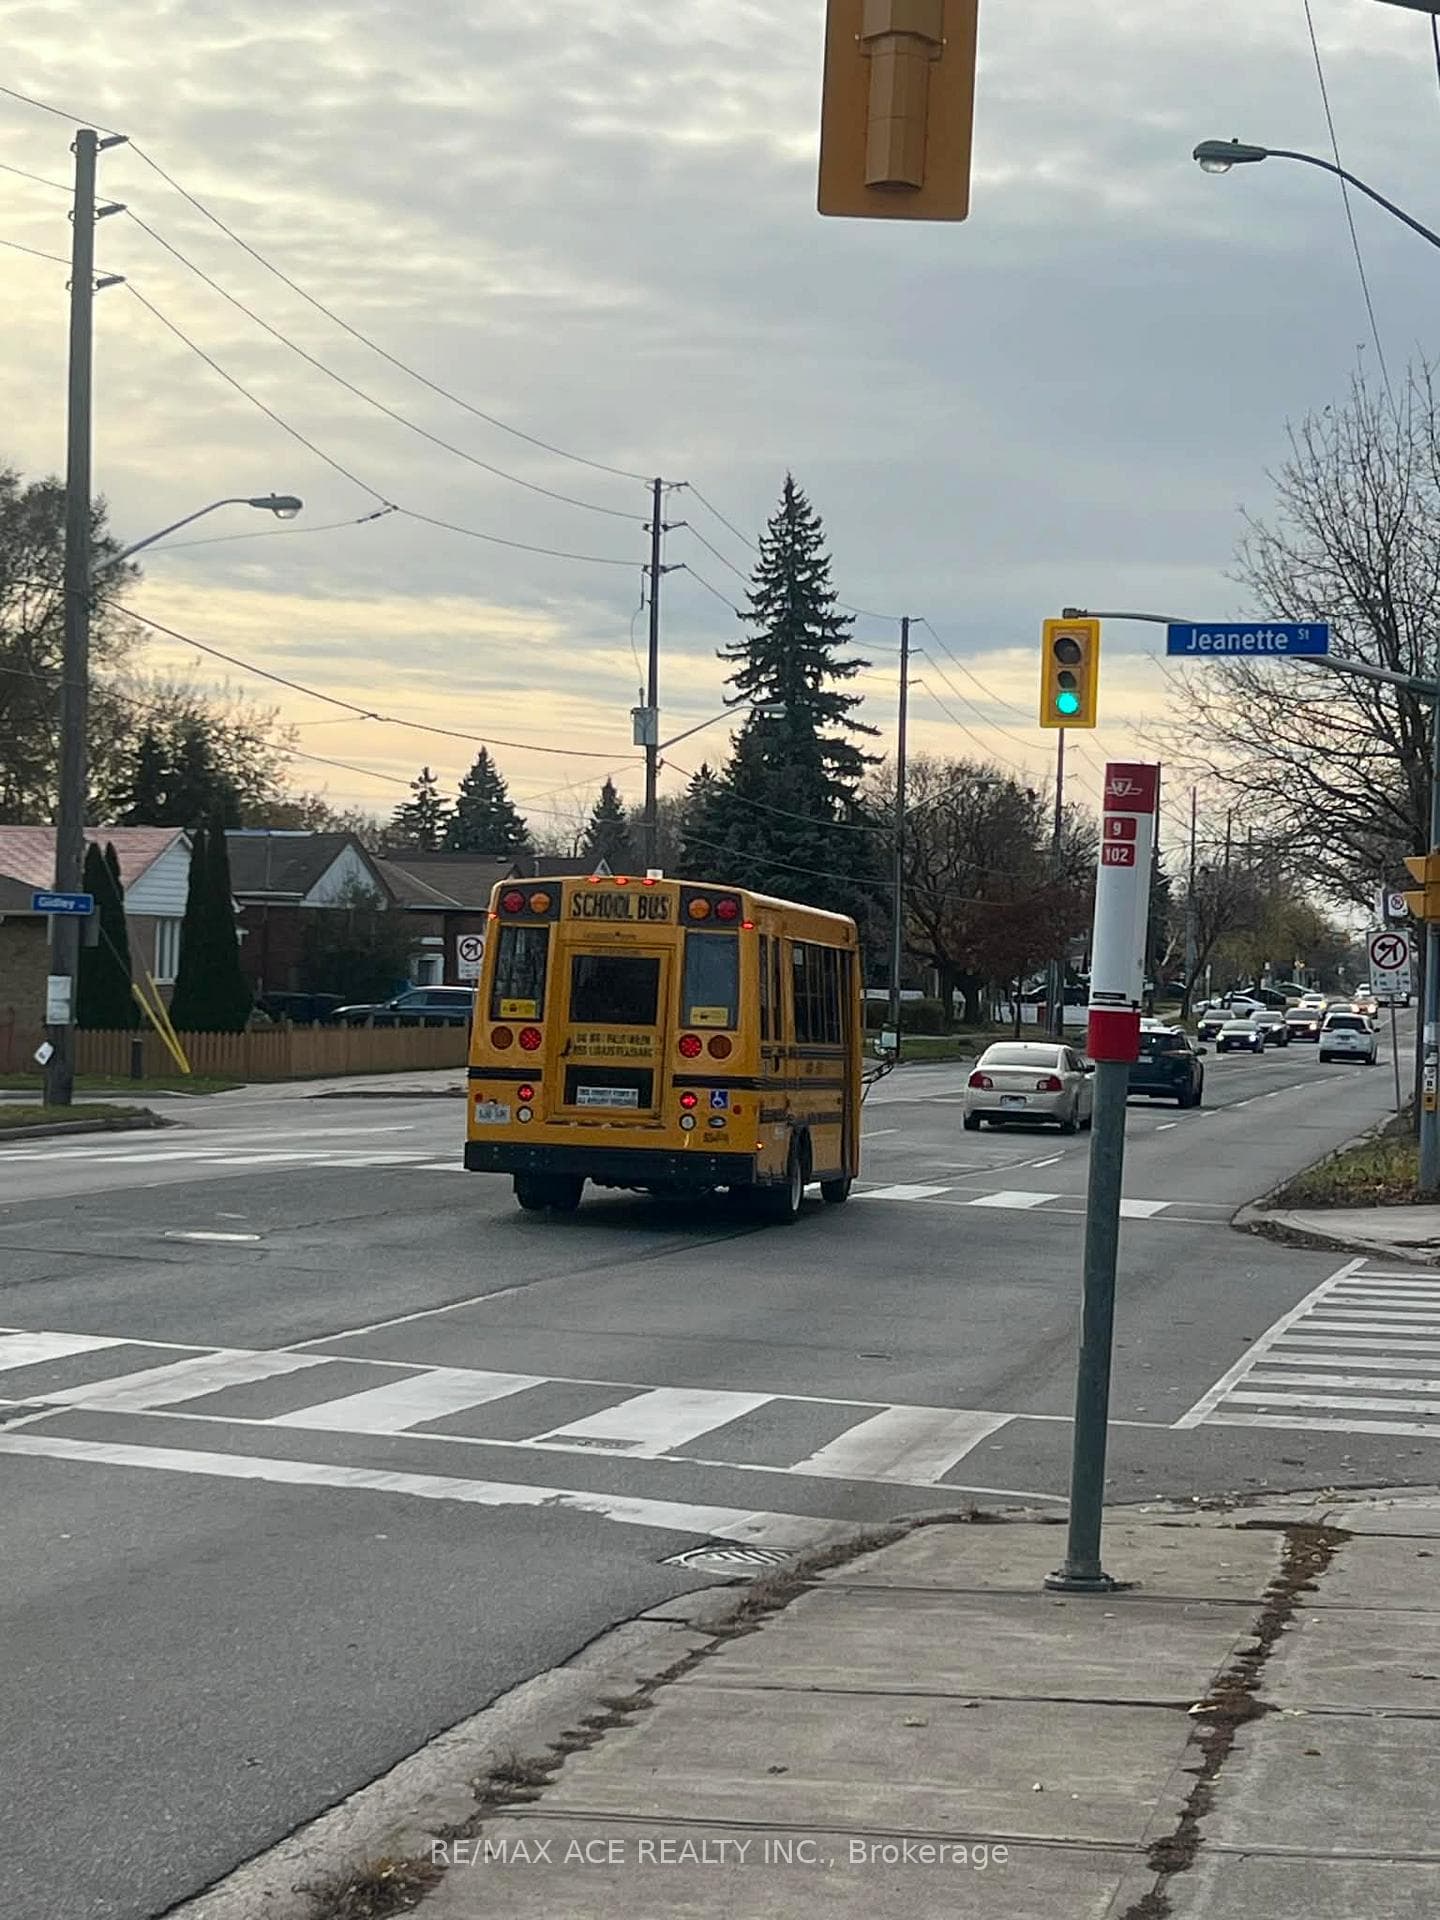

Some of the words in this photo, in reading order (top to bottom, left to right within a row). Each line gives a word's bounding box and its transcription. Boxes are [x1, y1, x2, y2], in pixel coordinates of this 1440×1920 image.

[1186, 628, 1289, 650] Jeanette
[1297, 629, 1310, 640] St
[1112, 821, 1122, 836] 9
[1104, 847, 1129, 862] 102
[572, 893, 634, 919] SCHOOL
[637, 895, 669, 920] BUS
